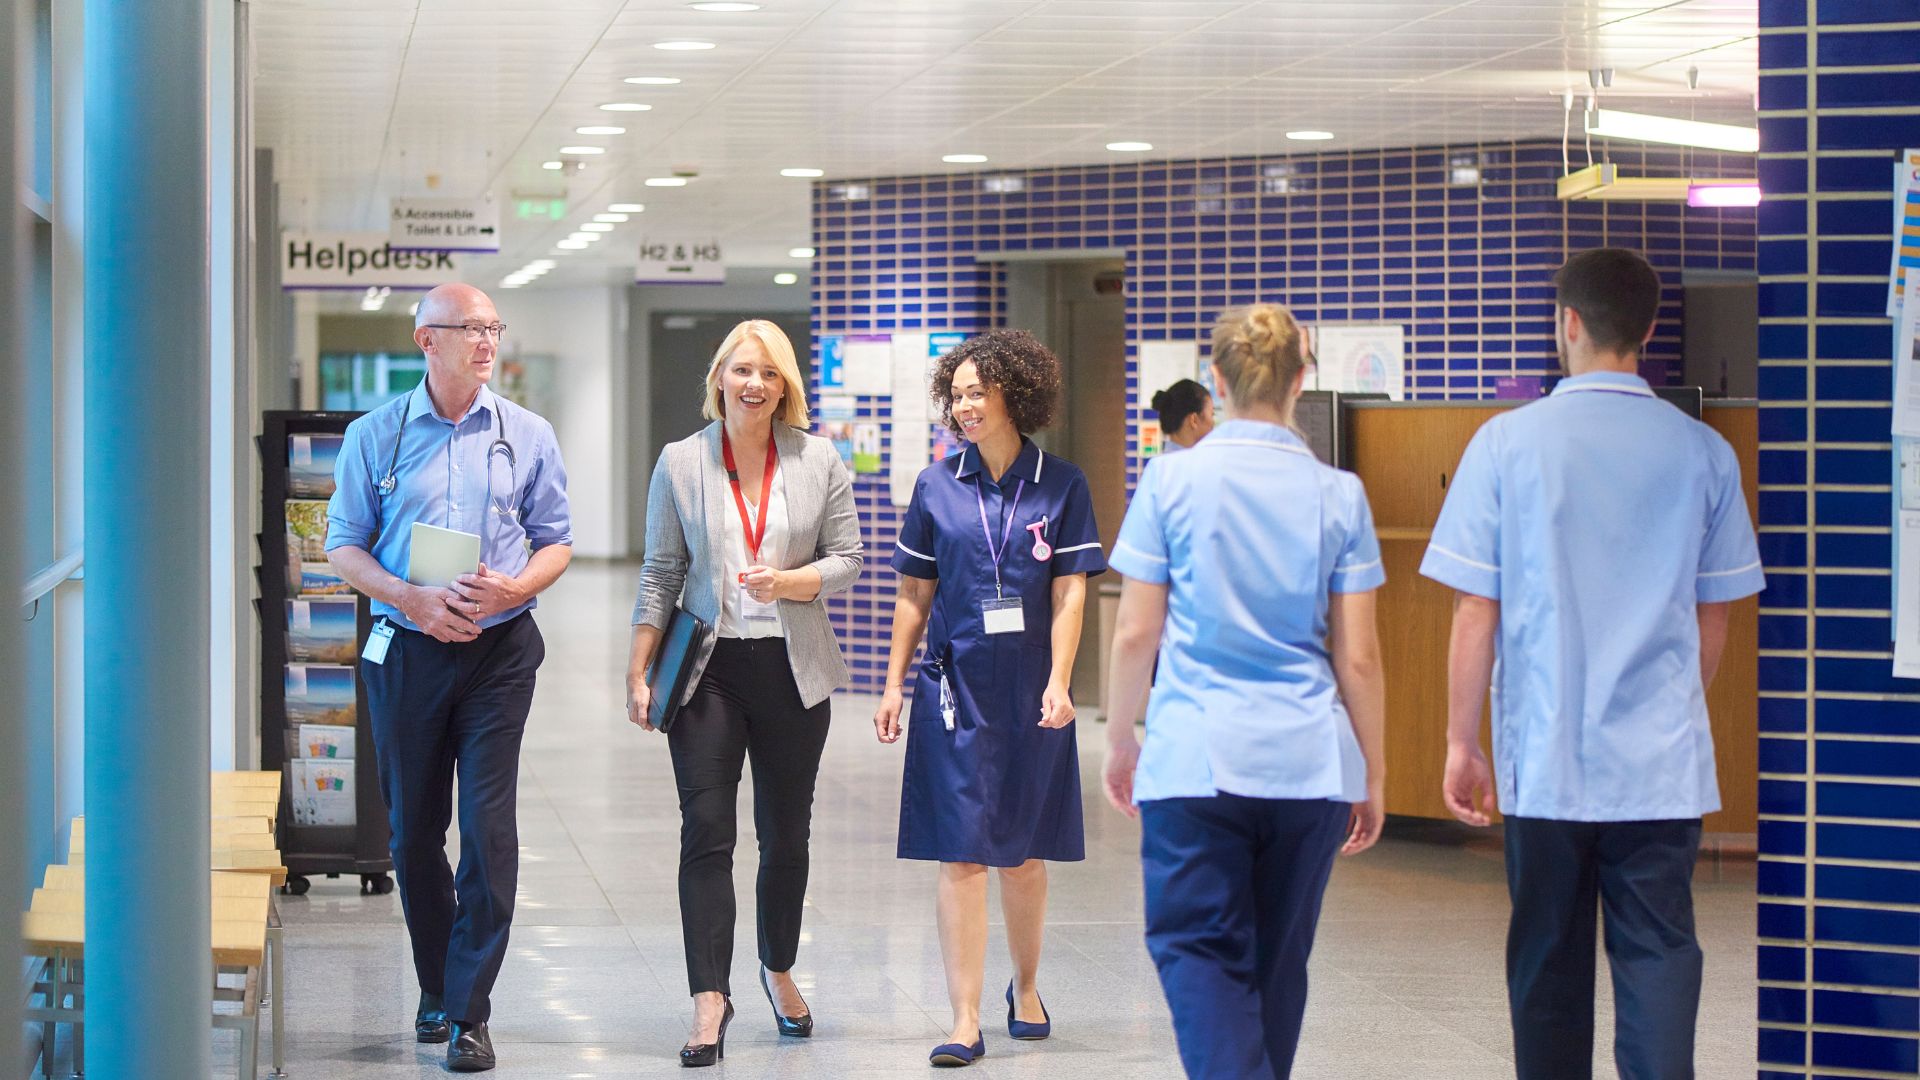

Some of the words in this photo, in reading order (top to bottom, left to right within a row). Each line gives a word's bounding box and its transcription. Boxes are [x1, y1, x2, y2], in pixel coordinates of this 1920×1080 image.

[405, 208, 474, 219] Accessible
[406, 224, 440, 235] Toilet
[444, 225, 453, 235] &
[457, 224, 477, 235] Lift
[288, 240, 454, 276] Helpdesk
[640, 244, 667, 261] H2
[673, 244, 687, 261] &
[693, 244, 721, 262] H3
